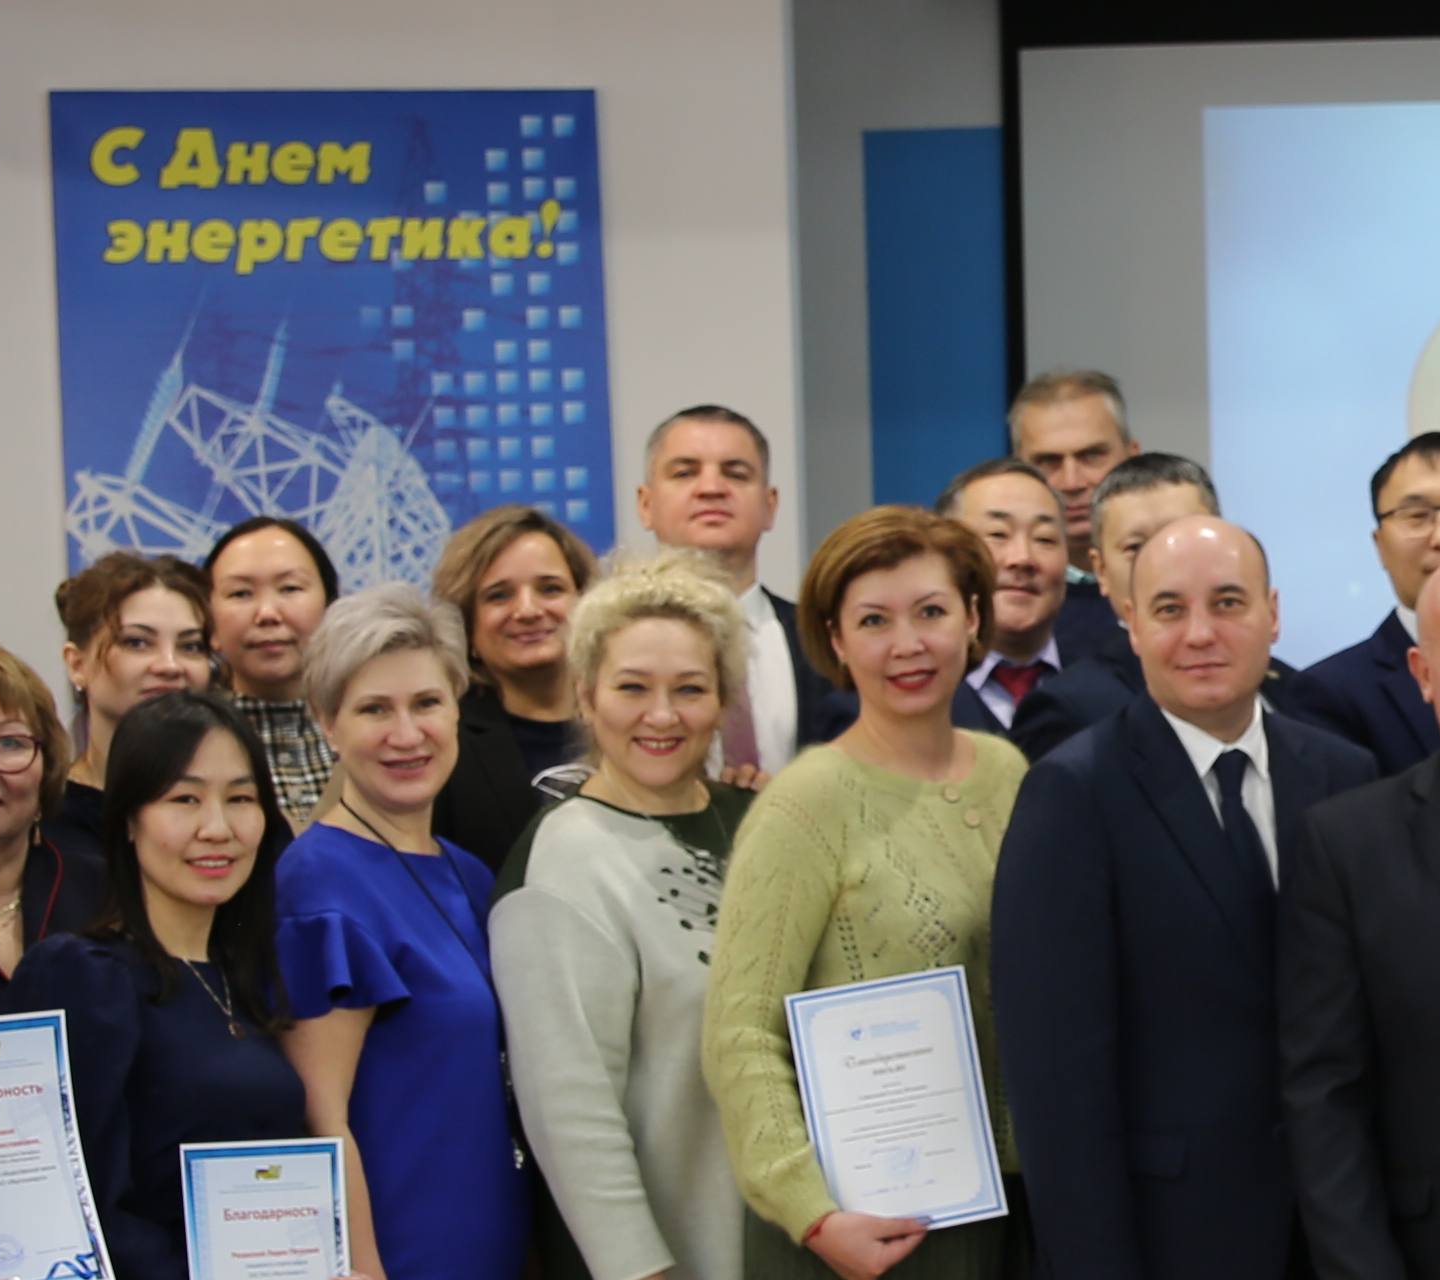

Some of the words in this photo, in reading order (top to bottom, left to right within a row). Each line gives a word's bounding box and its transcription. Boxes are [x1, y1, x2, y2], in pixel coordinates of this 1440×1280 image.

[90, 127, 146, 186] С
[159, 128, 372, 189] Днем
[103, 199, 562, 275] энергетика!
[223, 1206, 319, 1221] Благодарность
